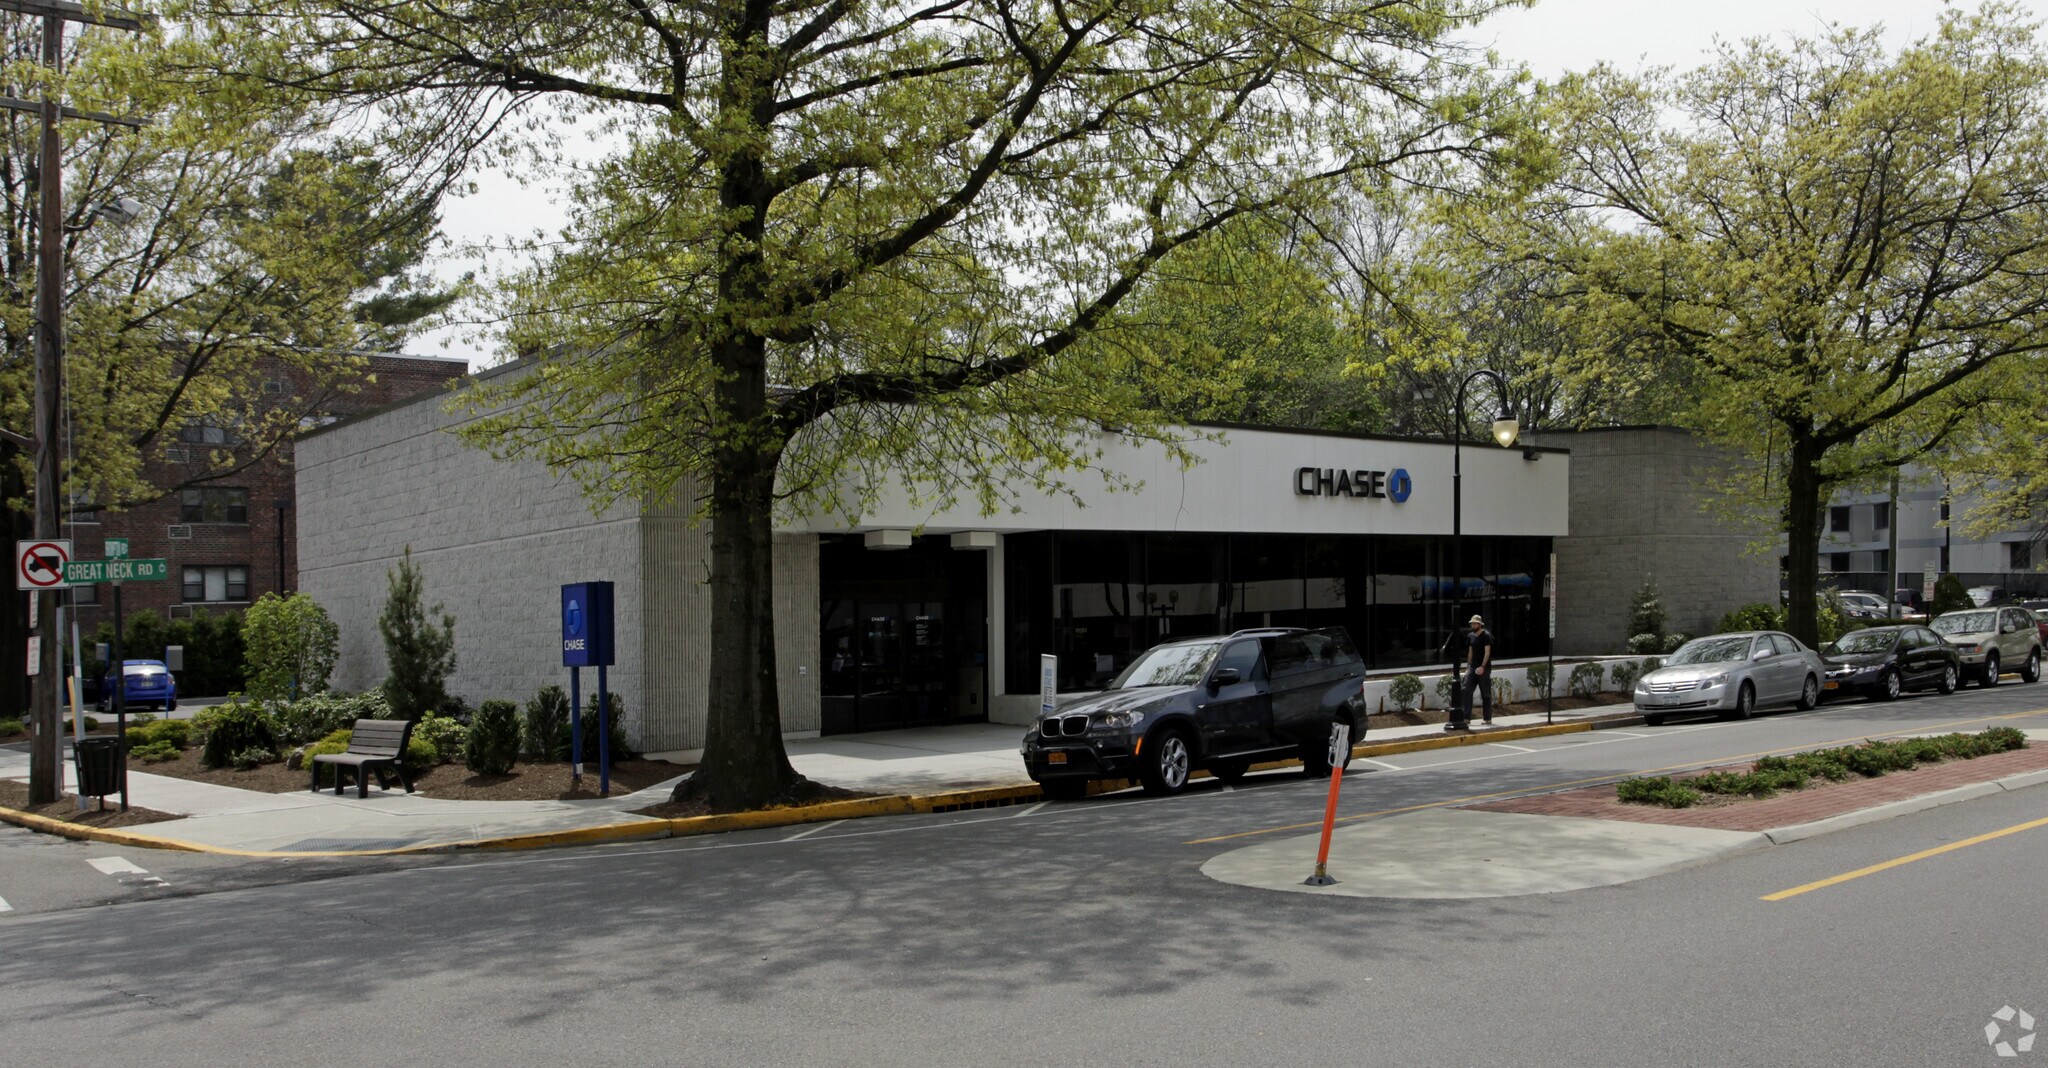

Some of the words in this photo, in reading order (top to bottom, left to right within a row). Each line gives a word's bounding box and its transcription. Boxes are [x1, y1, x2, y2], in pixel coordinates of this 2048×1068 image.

[1294, 467, 1386, 498] CHASE
[67, 563, 103, 580] GREAT
[105, 562, 133, 579] NECK
[138, 563, 153, 576] RD
[564, 639, 585, 650] CHASE
